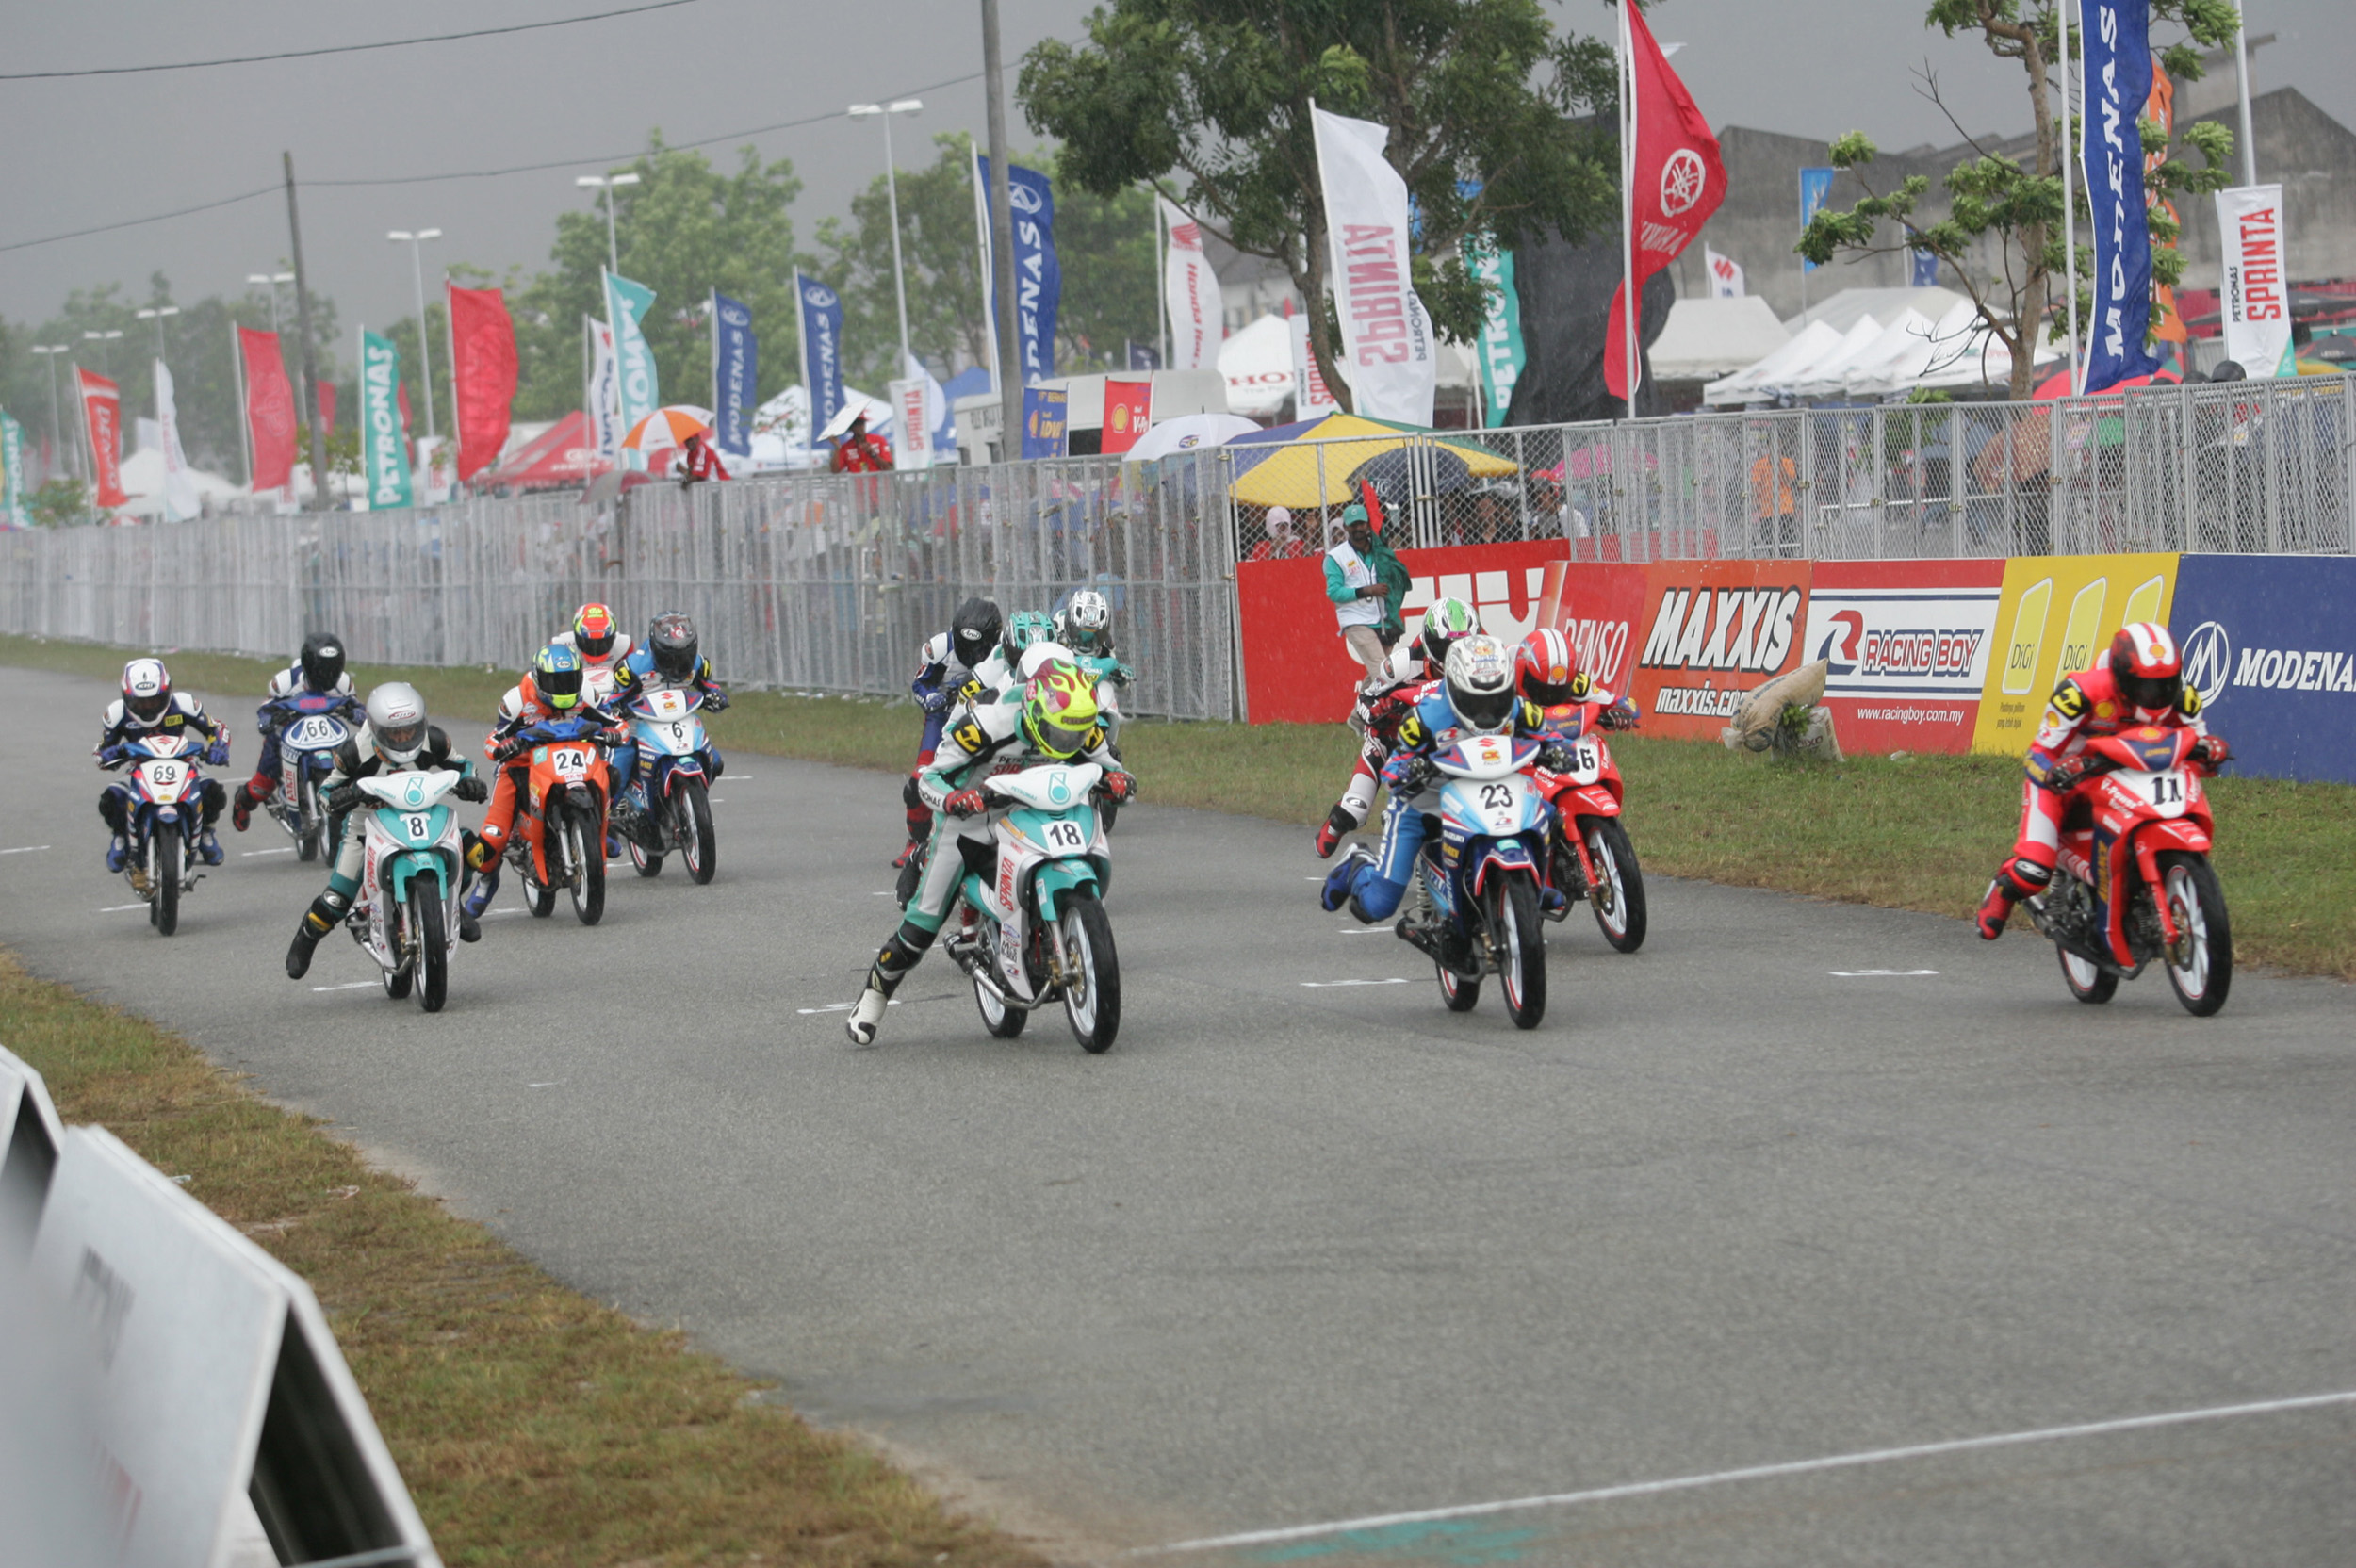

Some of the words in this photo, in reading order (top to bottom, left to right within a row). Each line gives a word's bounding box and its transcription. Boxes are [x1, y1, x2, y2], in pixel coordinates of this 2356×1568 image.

[2239, 207, 2282, 321] SPRINTA
[2228, 266, 2240, 322] PETRONAS
[728, 330, 744, 446] MODENAS
[366, 345, 402, 505] PETRONAS
[1640, 585, 1802, 676] MAXXIS
[1564, 618, 1628, 685] DENSO
[1862, 629, 1936, 677] RACING
[1933, 629, 1986, 678] BOY
[2010, 643, 2035, 670] DiGi
[2062, 644, 2088, 671] DiGi
[2233, 647, 2356, 693] MODENA
[1857, 705, 1965, 726] www.racingboy.com.my
[305, 721, 328, 738] 66
[672, 721, 683, 739] 6
[154, 765, 176, 781] 69
[555, 752, 583, 771] 24
[1536, 765, 1557, 779] ower
[920, 789, 941, 806] RONAS
[1010, 785, 1037, 801] PETRONAS
[1479, 784, 1513, 810] 23
[2151, 776, 2181, 806] 11
[410, 817, 424, 837] 8
[1048, 823, 1081, 847] 18
[1000, 856, 1016, 912] SPRINTA
